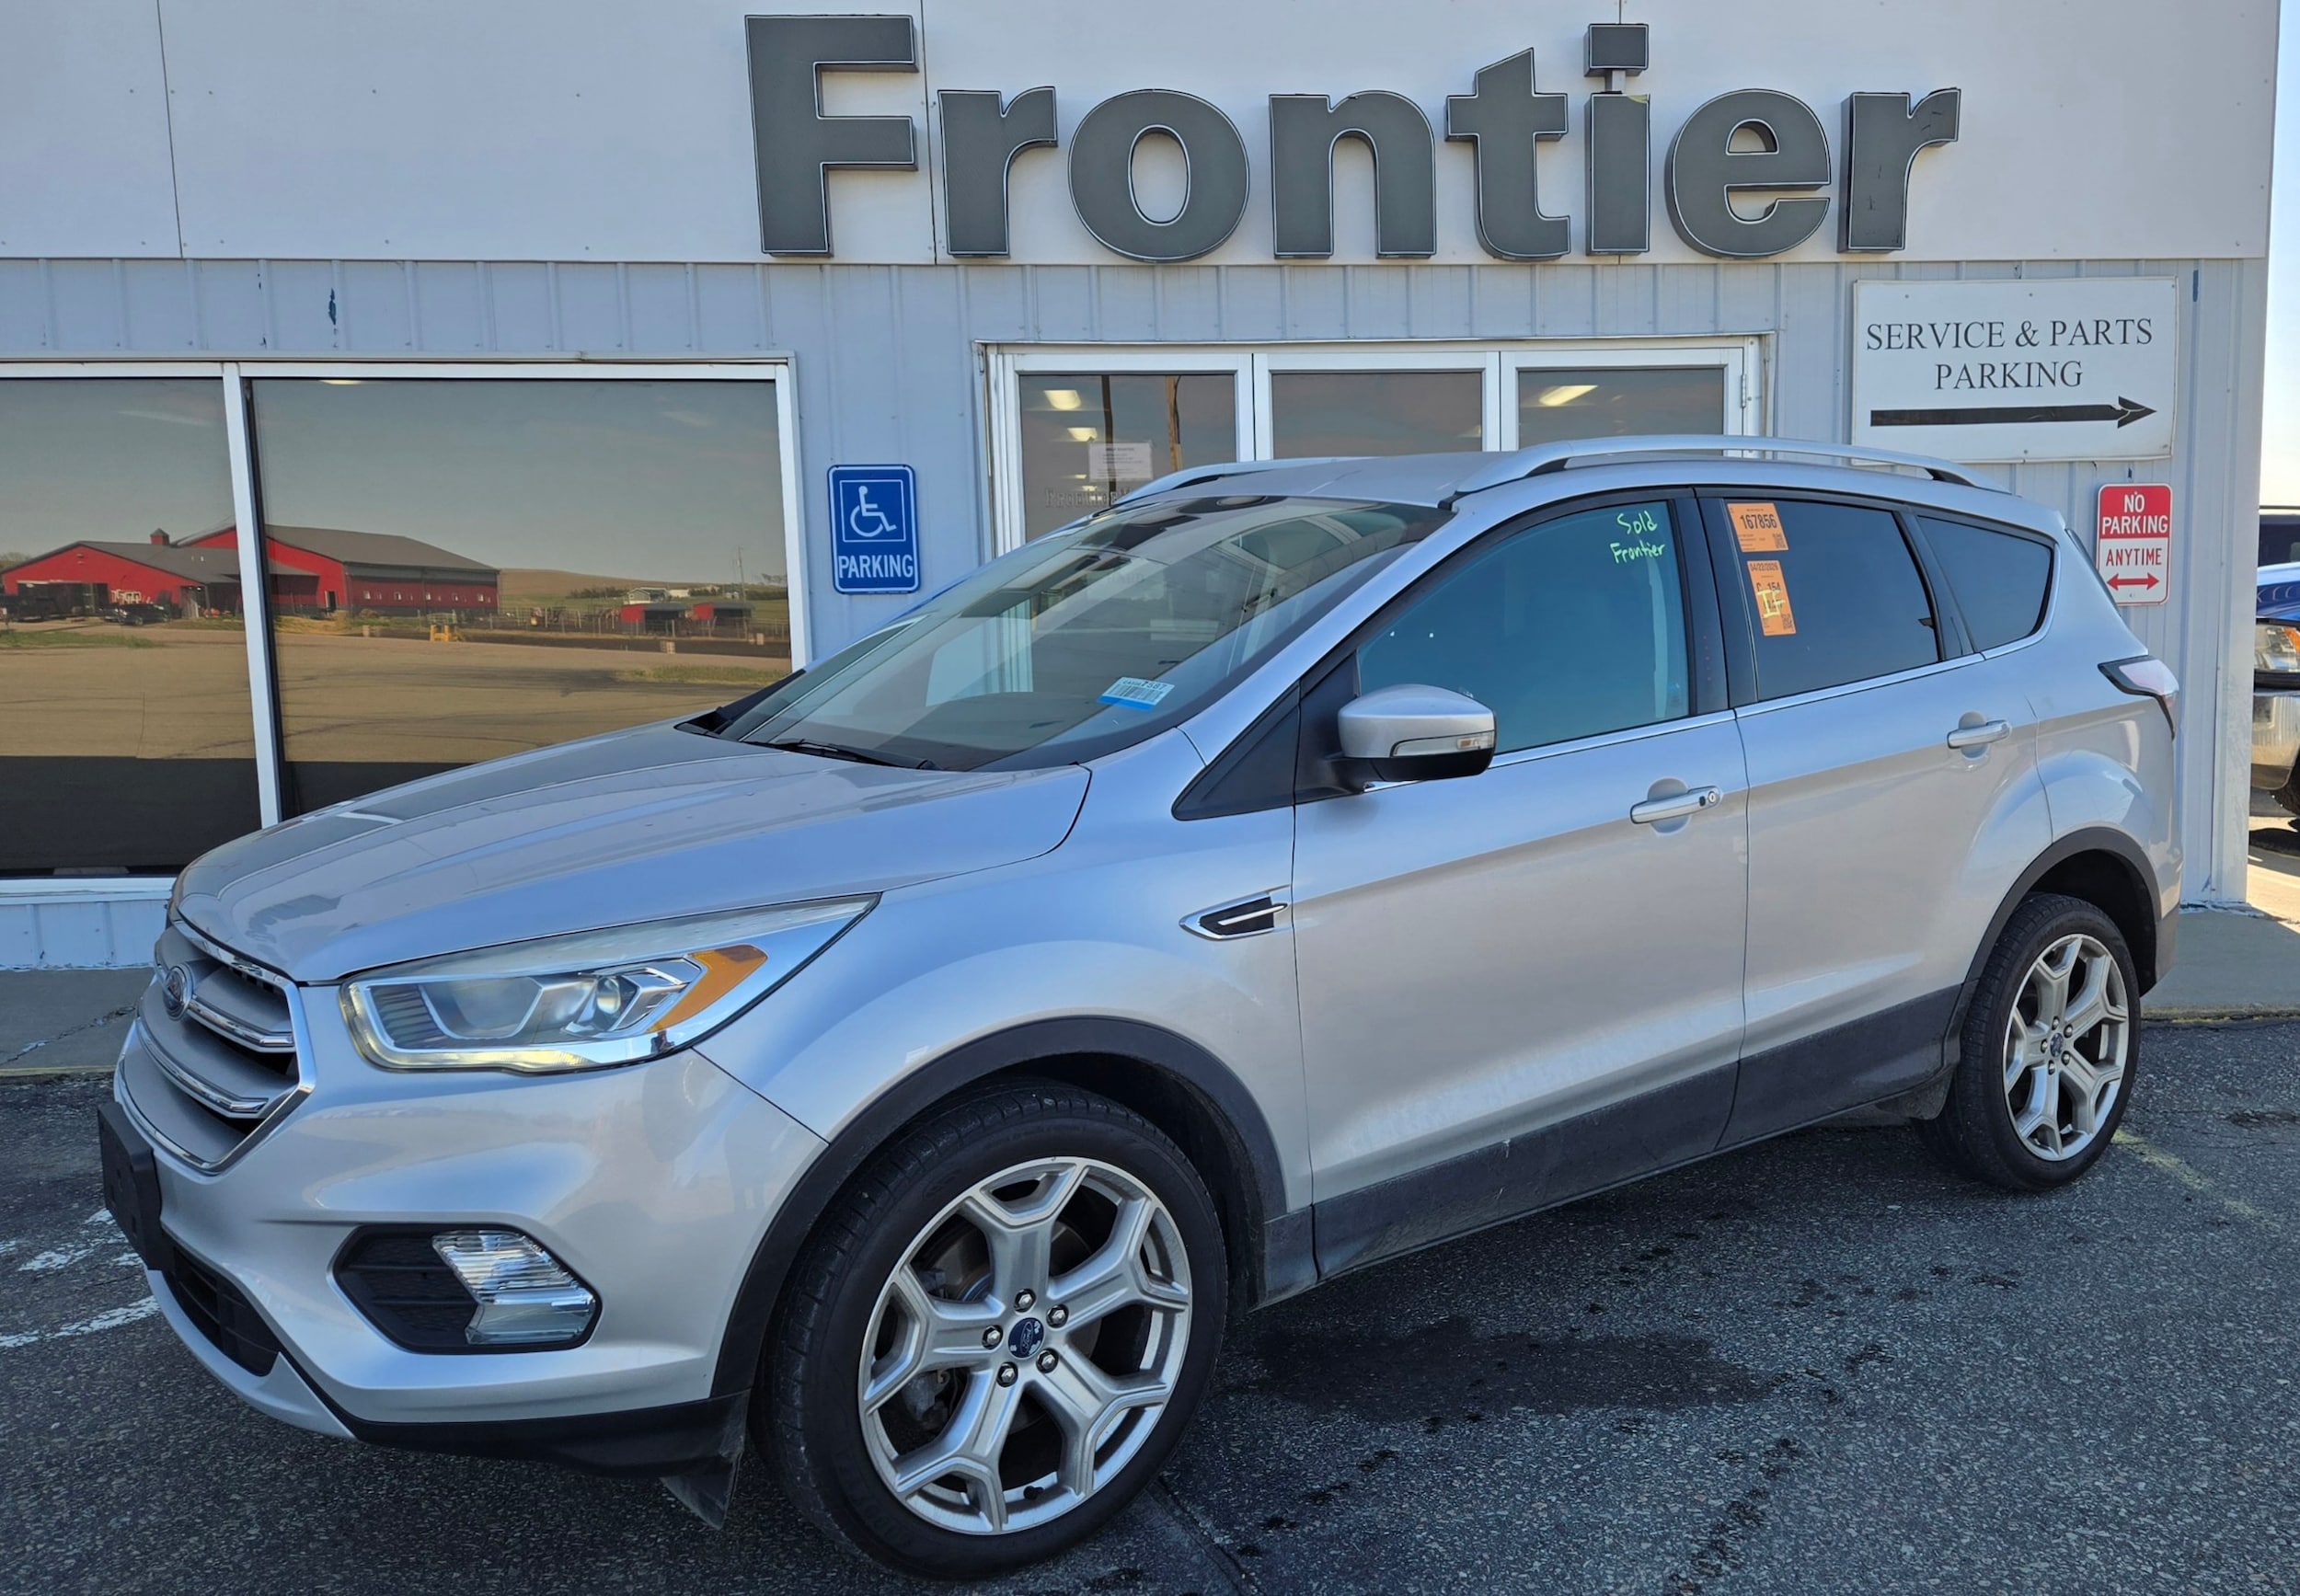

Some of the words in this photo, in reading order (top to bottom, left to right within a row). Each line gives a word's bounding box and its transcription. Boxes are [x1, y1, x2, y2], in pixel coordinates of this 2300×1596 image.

[744, 13, 1961, 264] Frontier
[1866, 322, 2006, 350] SERVICE
[2015, 320, 2041, 349] &
[2049, 318, 2154, 347] PARTS
[1934, 361, 2084, 390] PARKING
[2123, 494, 2145, 513] NO
[1616, 510, 1658, 534] Sold
[1740, 513, 1777, 529] 167856
[2101, 515, 2168, 535] PARKING
[1610, 540, 1665, 564] Frontier
[2105, 547, 2163, 567] ANYTIME
[838, 554, 914, 579] PARKING
